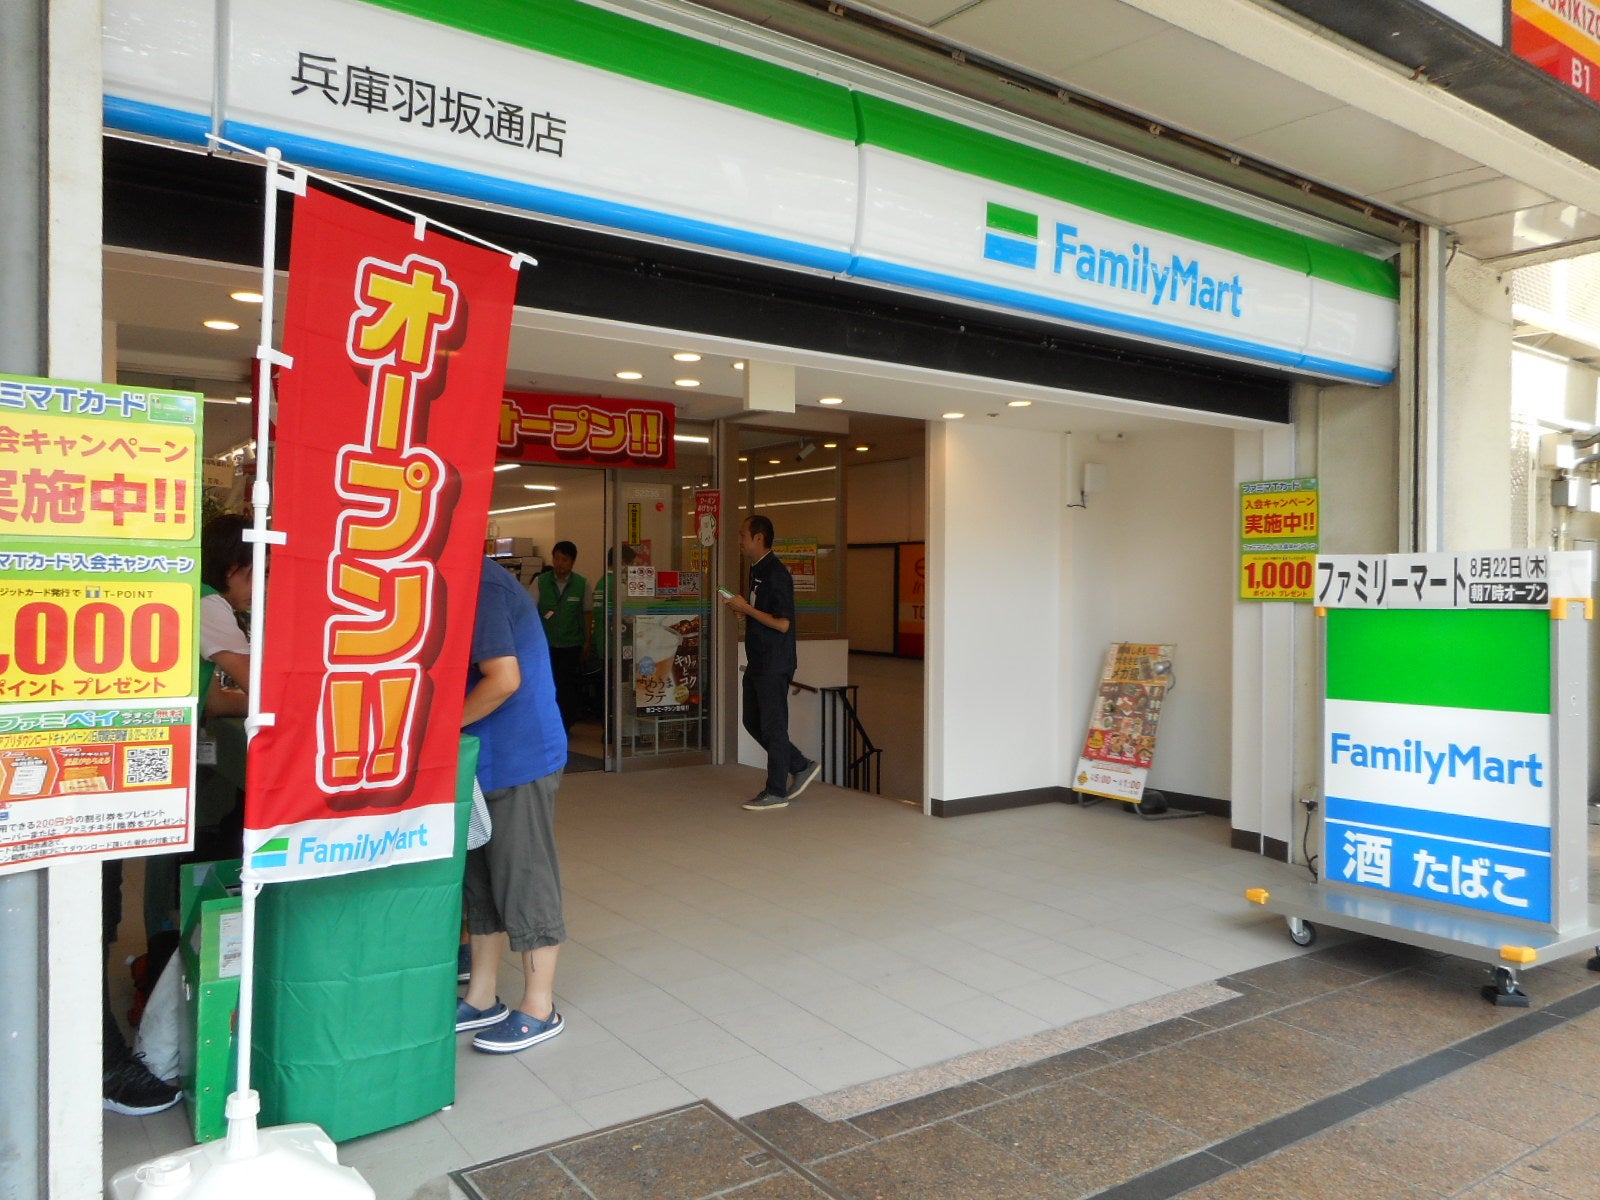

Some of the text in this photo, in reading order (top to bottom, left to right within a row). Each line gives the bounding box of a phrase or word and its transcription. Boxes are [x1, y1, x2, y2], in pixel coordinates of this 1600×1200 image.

[1571, 57, 1590, 94] B1
[291, 52, 566, 157] 兵庫羽坂通店
[1053, 221, 1243, 318] FamilyMart
[0, 468, 187, 526] 施中!!
[1244, 561, 1312, 589] 1,000
[1318, 557, 1466, 606] ファミリーマート
[1471, 582, 1547, 602] 朝7時オープン
[74, 677, 166, 694] プレゼント
[1331, 732, 1543, 788] FamilyMart
[298, 823, 428, 864] FamilyMart
[1342, 830, 1528, 908] 酒 たばこ
